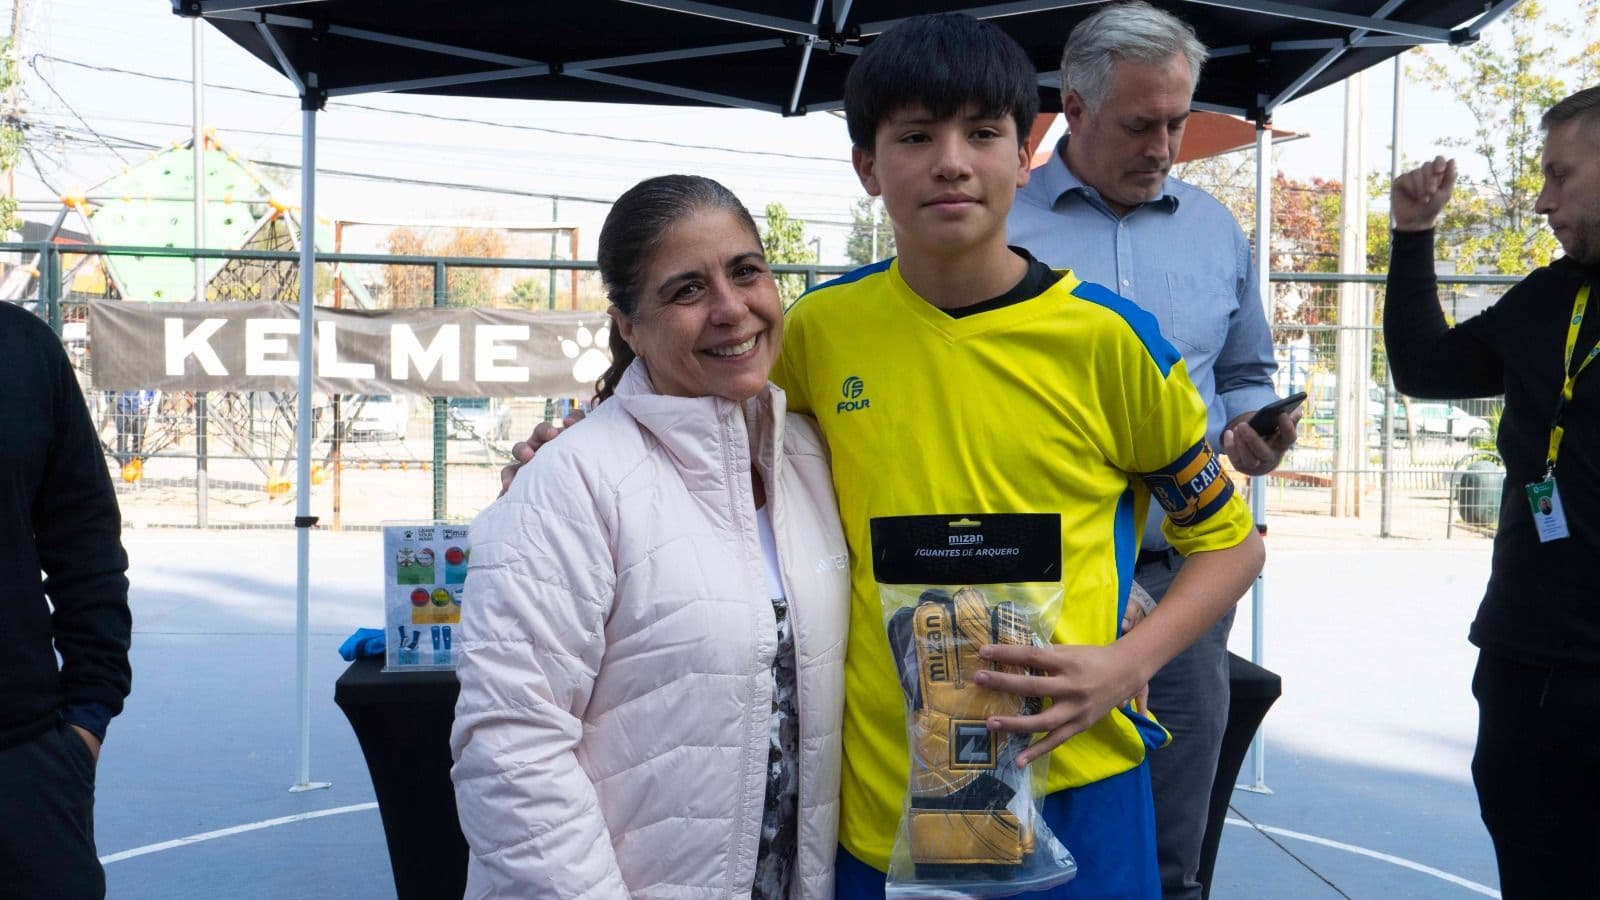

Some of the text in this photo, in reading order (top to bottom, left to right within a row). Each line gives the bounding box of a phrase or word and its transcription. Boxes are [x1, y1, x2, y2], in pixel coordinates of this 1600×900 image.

[164, 317, 530, 382] KELME
[836, 399, 870, 415] FOUR
[1190, 452, 1221, 494] CAPI
[948, 534, 984, 544] mizan
[962, 548, 975, 557] DE
[975, 547, 1020, 557] ARQUERO
[925, 614, 946, 683] mizan
